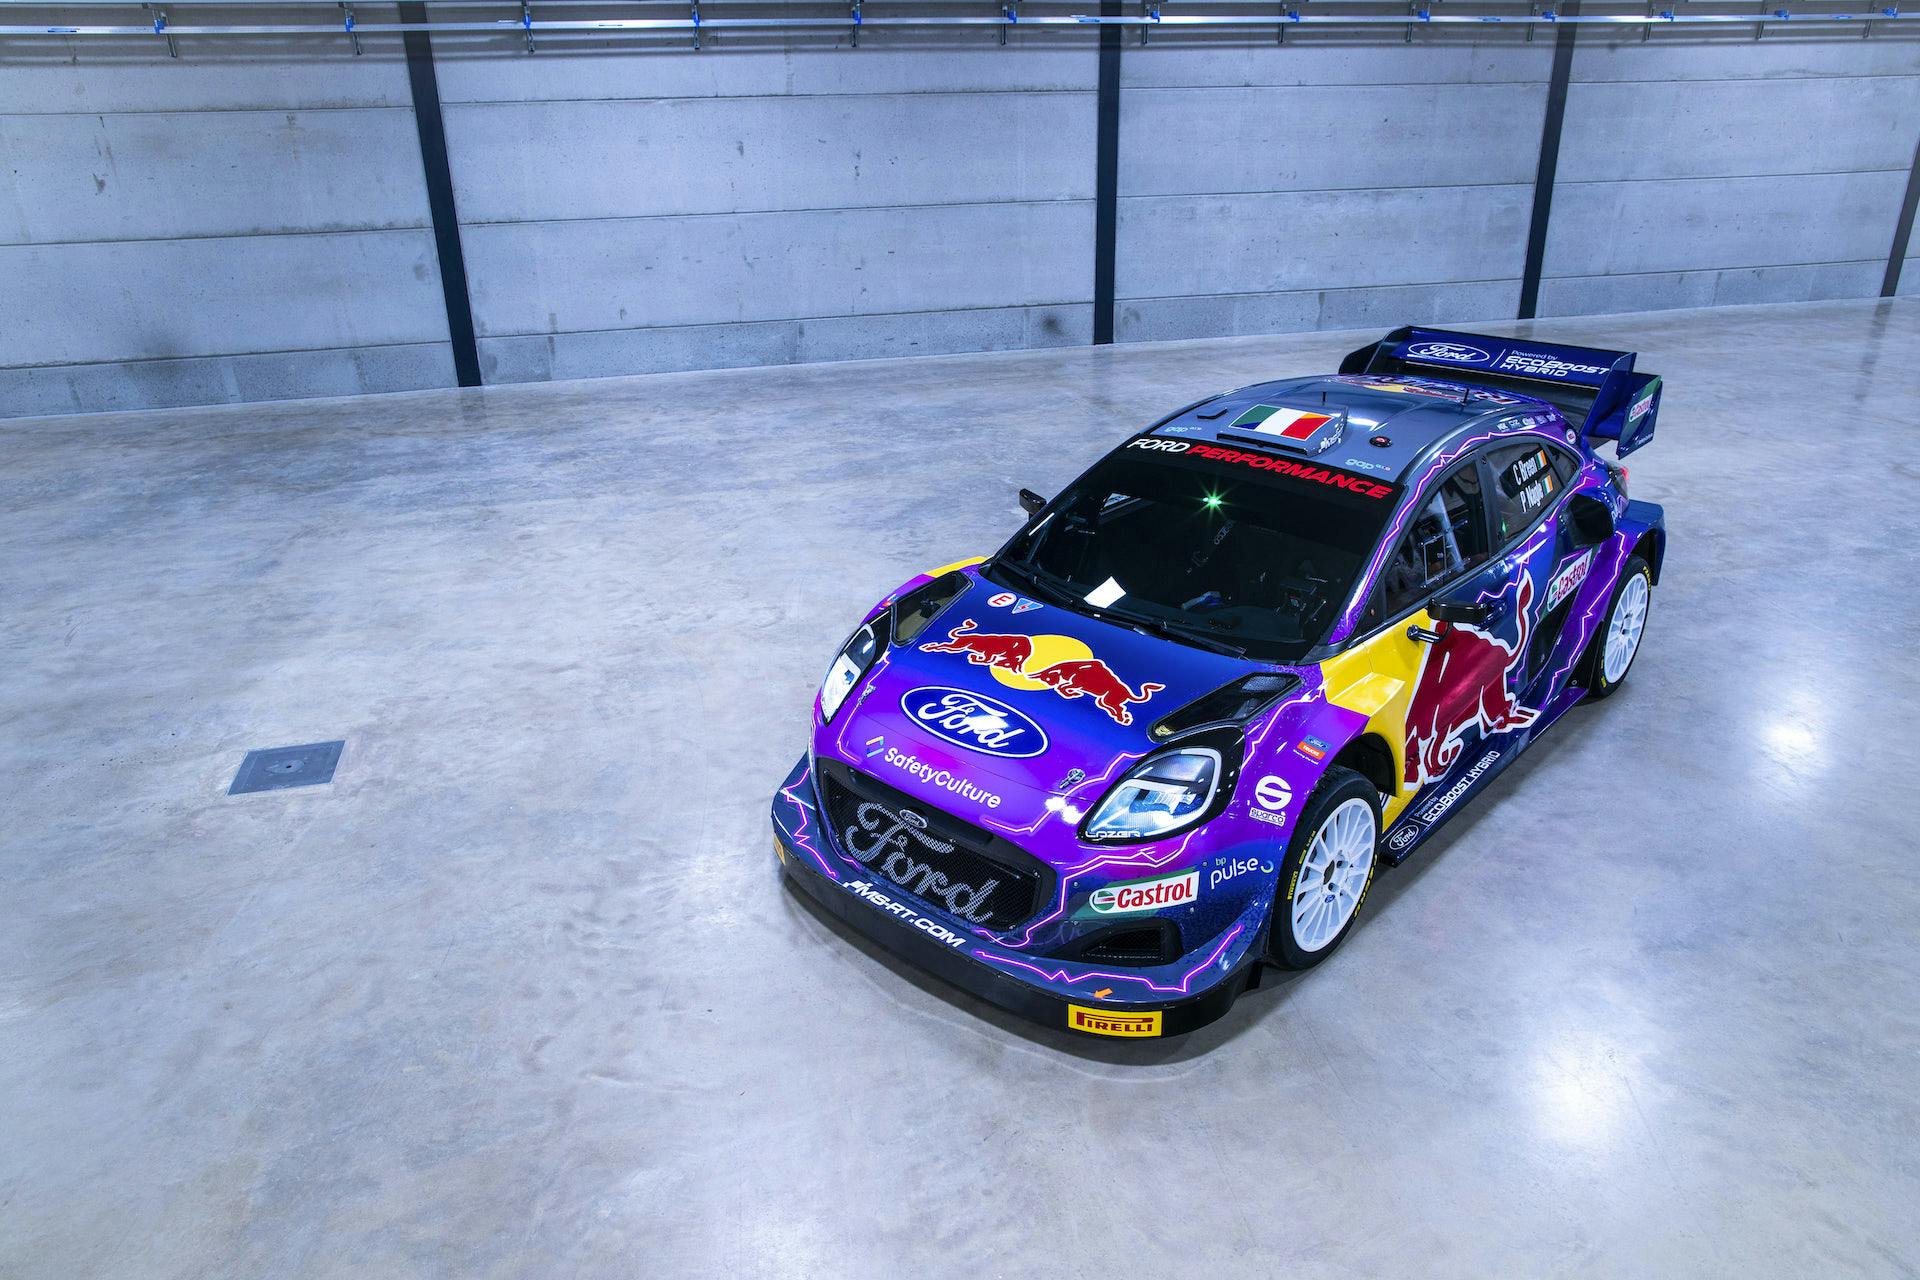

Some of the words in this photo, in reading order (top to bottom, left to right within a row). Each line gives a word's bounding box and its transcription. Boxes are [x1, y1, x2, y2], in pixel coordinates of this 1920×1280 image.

[1419, 344, 1476, 361] Ford
[1511, 349, 1548, 360] Powered
[1548, 353, 1559, 361] by
[1500, 363, 1569, 377] HYBRID
[1126, 437, 1191, 454] FORD
[1186, 444, 1394, 499] PERFORMANCE
[1345, 458, 1375, 470] gap
[1512, 464, 1522, 486] C
[1519, 456, 1538, 482] Breen
[1520, 491, 1527, 513] P
[1556, 554, 1589, 601] Castrol
[917, 693, 1026, 749] Ford
[884, 747, 1002, 809] SafetyCulture
[1466, 750, 1501, 781] HYBRID
[1251, 808, 1284, 824] sparco
[1393, 828, 1417, 847] Ford
[845, 802, 1001, 923] Ford
[1210, 857, 1259, 890] pulse
[1215, 856, 1227, 867] bp
[1117, 877, 1193, 909] Castrol
[855, 884, 966, 948] MS-RT.COM
[1076, 1011, 1154, 1032] PIRELLI
